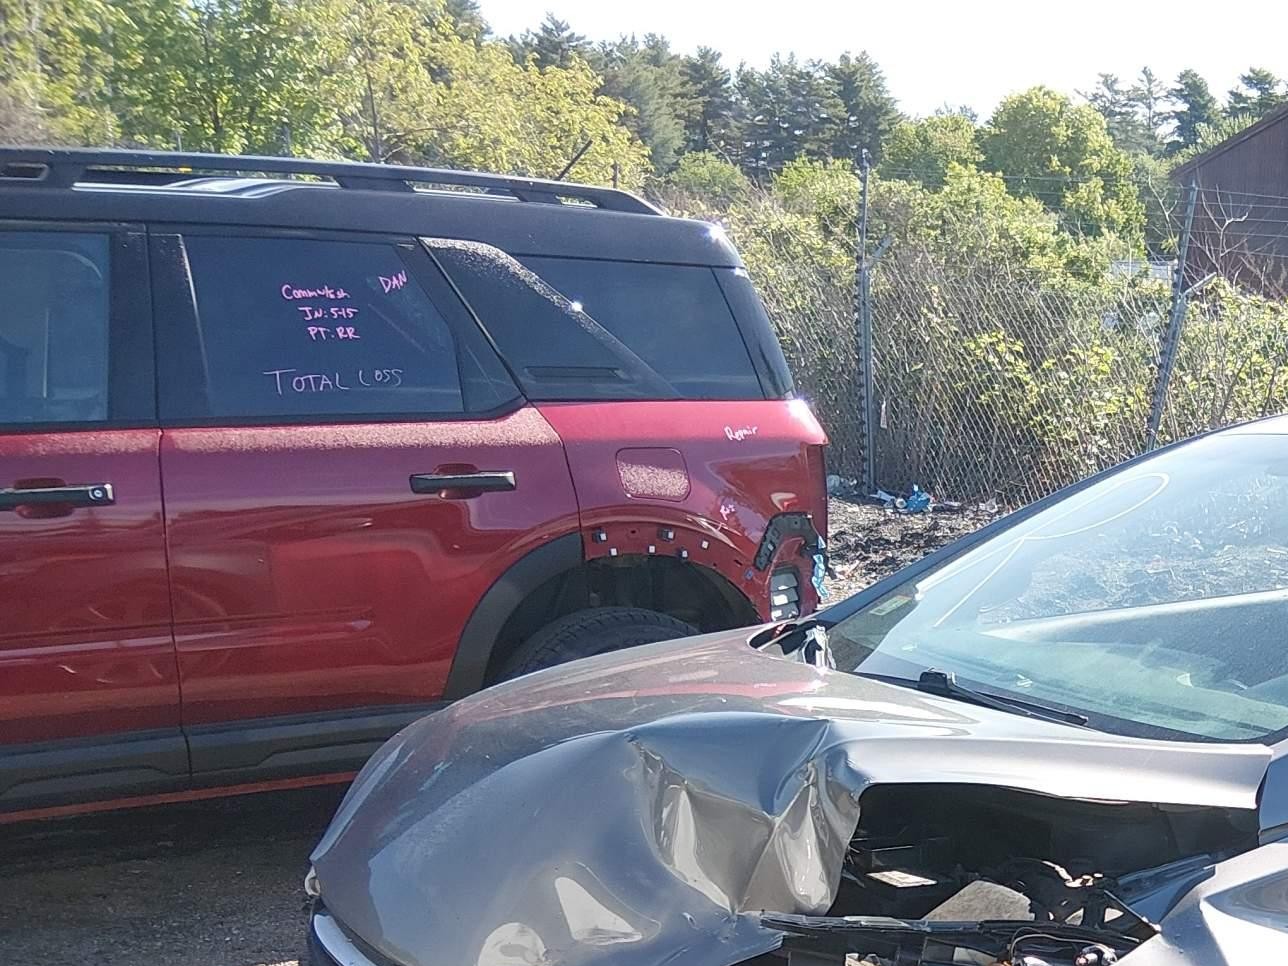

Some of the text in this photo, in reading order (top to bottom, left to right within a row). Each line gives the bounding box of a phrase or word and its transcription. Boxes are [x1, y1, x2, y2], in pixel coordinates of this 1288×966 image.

[378, 269, 408, 294] DAN
[336, 326, 360, 339] RR
[263, 368, 403, 396] TOTAL LOSS
